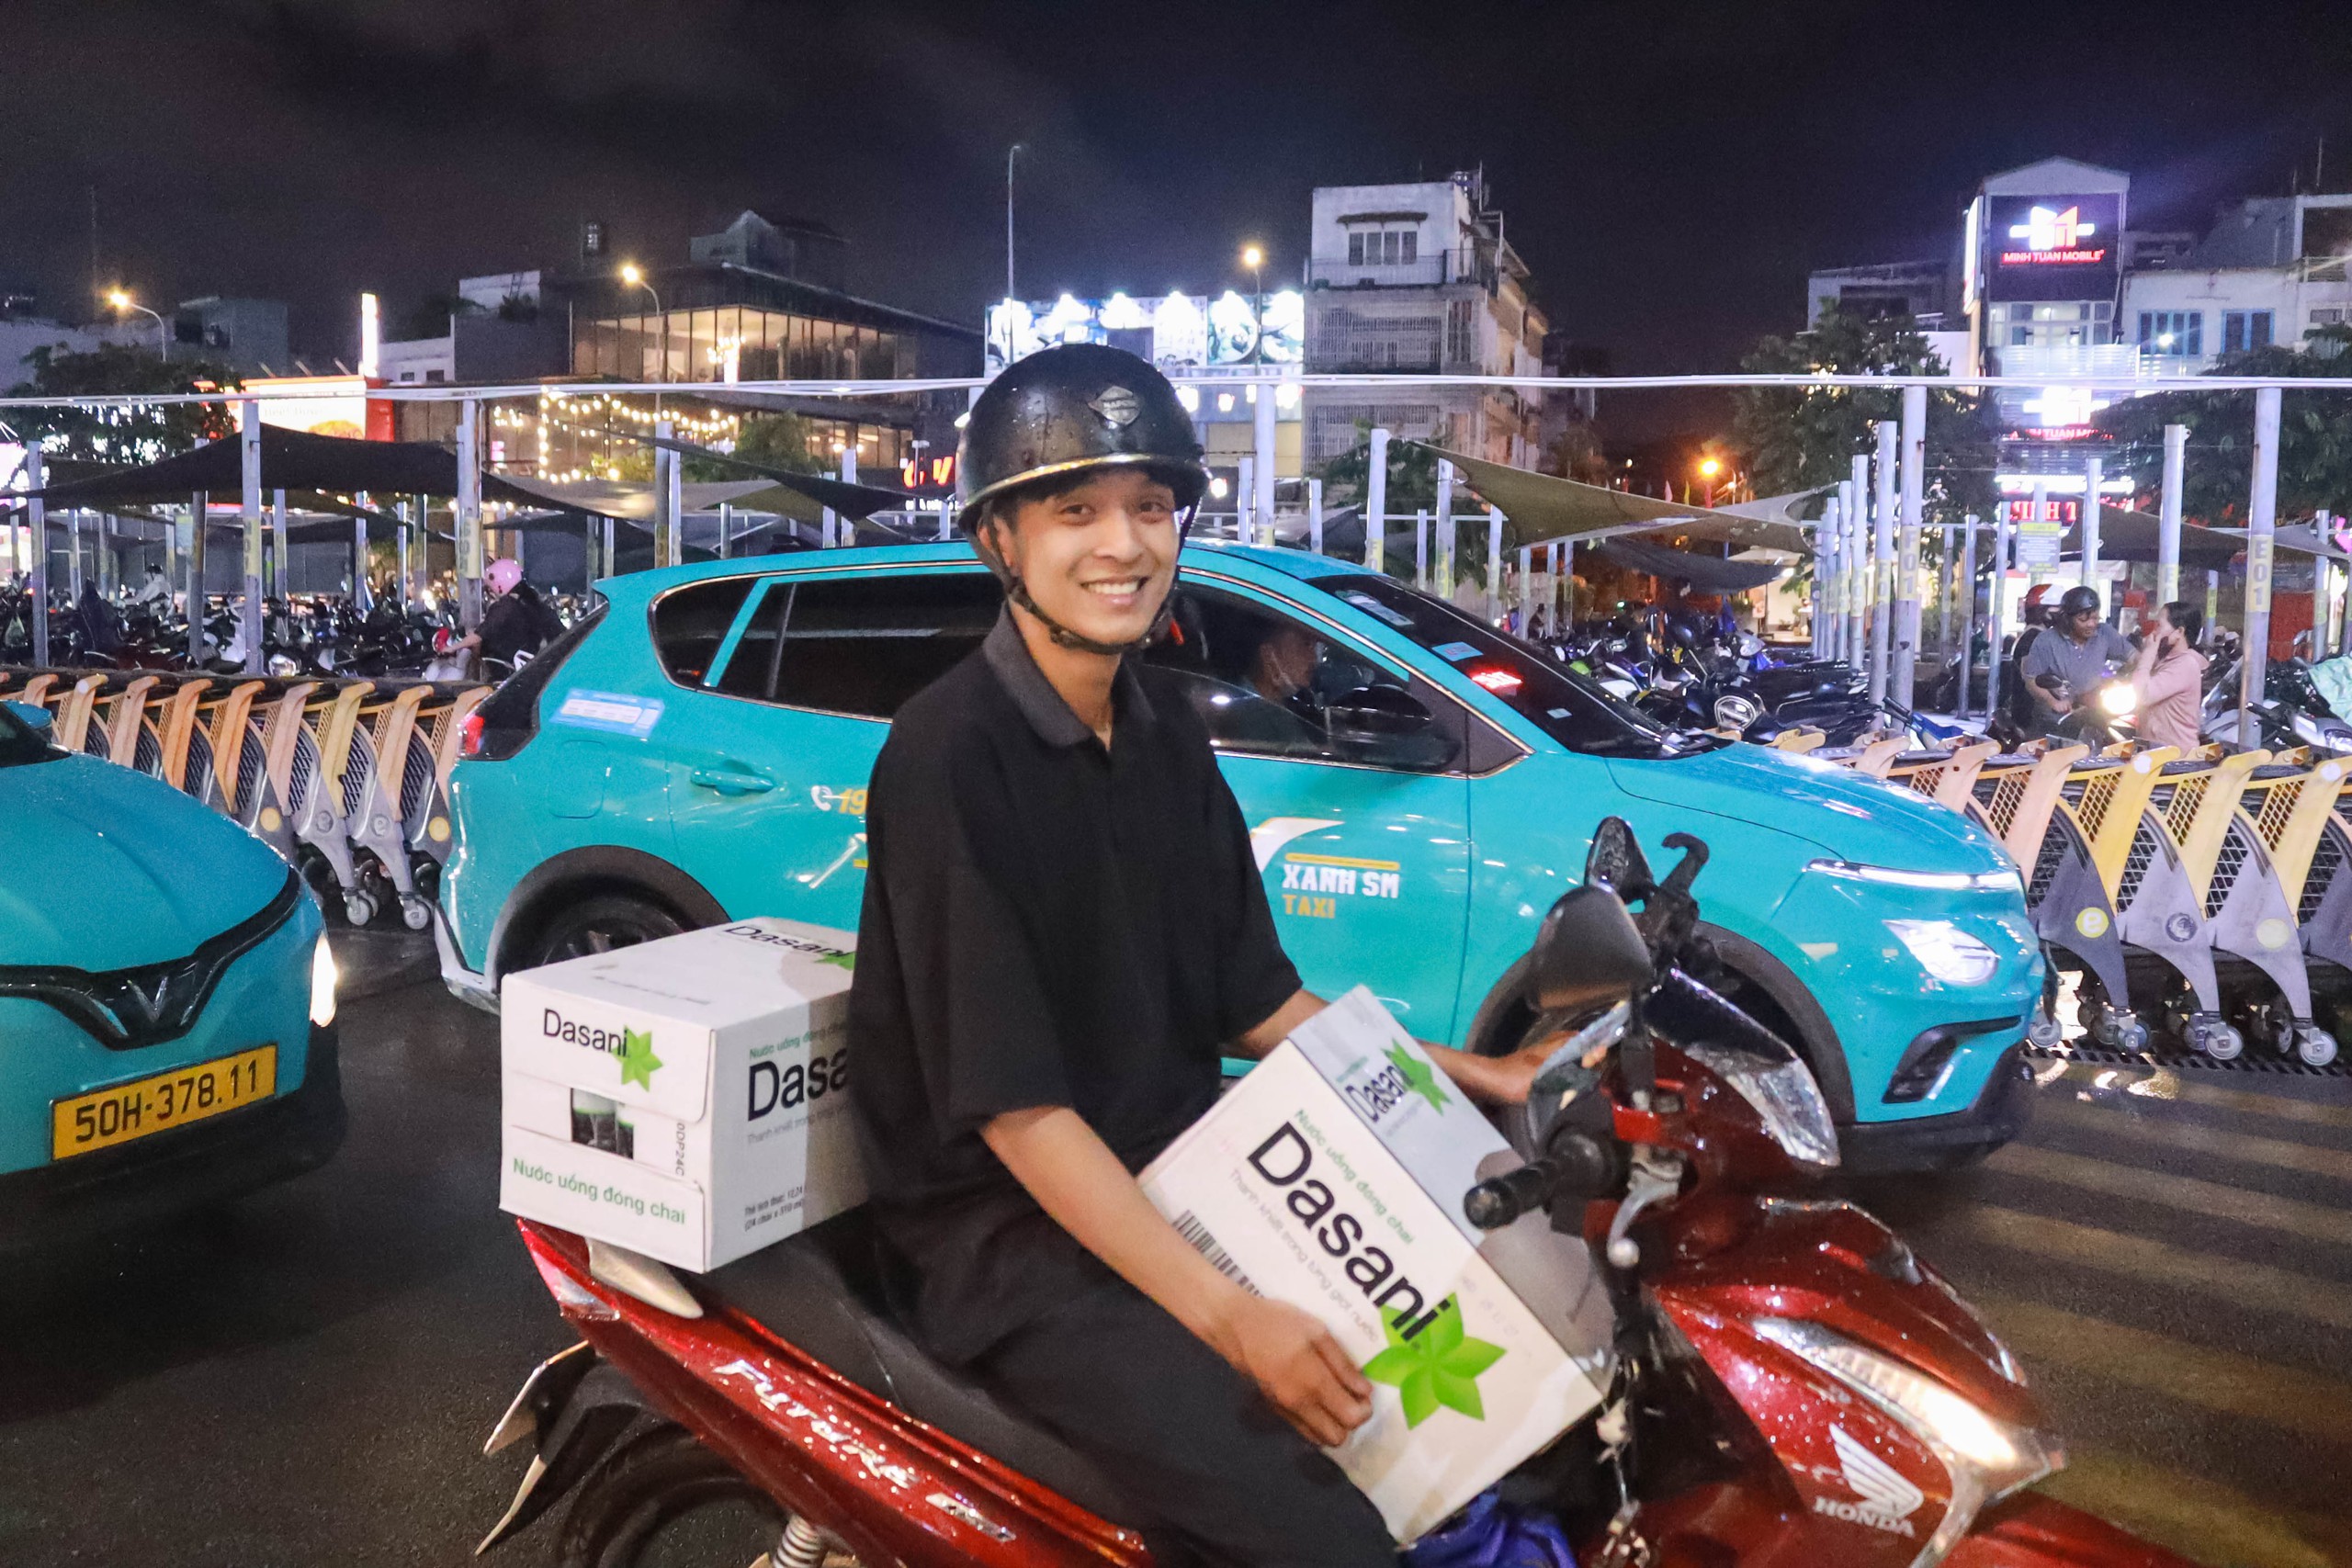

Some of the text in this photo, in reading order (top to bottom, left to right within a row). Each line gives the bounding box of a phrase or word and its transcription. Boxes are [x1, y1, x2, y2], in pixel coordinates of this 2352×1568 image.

[2003, 252, 2031, 264] MINH
[1903, 530, 1917, 594] F01
[2253, 540, 2268, 606] E01
[1282, 863, 1400, 899] XANH SM
[1283, 894, 1336, 919] TAXI
[544, 1008, 628, 1057] Dasani
[75, 1059, 258, 1143] 50H-378.11
[513, 1157, 686, 1224] Nước uống đóng chai
[1247, 1121, 1452, 1342] Dasani
[1386, 1216, 1416, 1244] chai
[1812, 1495, 1916, 1539] HONDA
